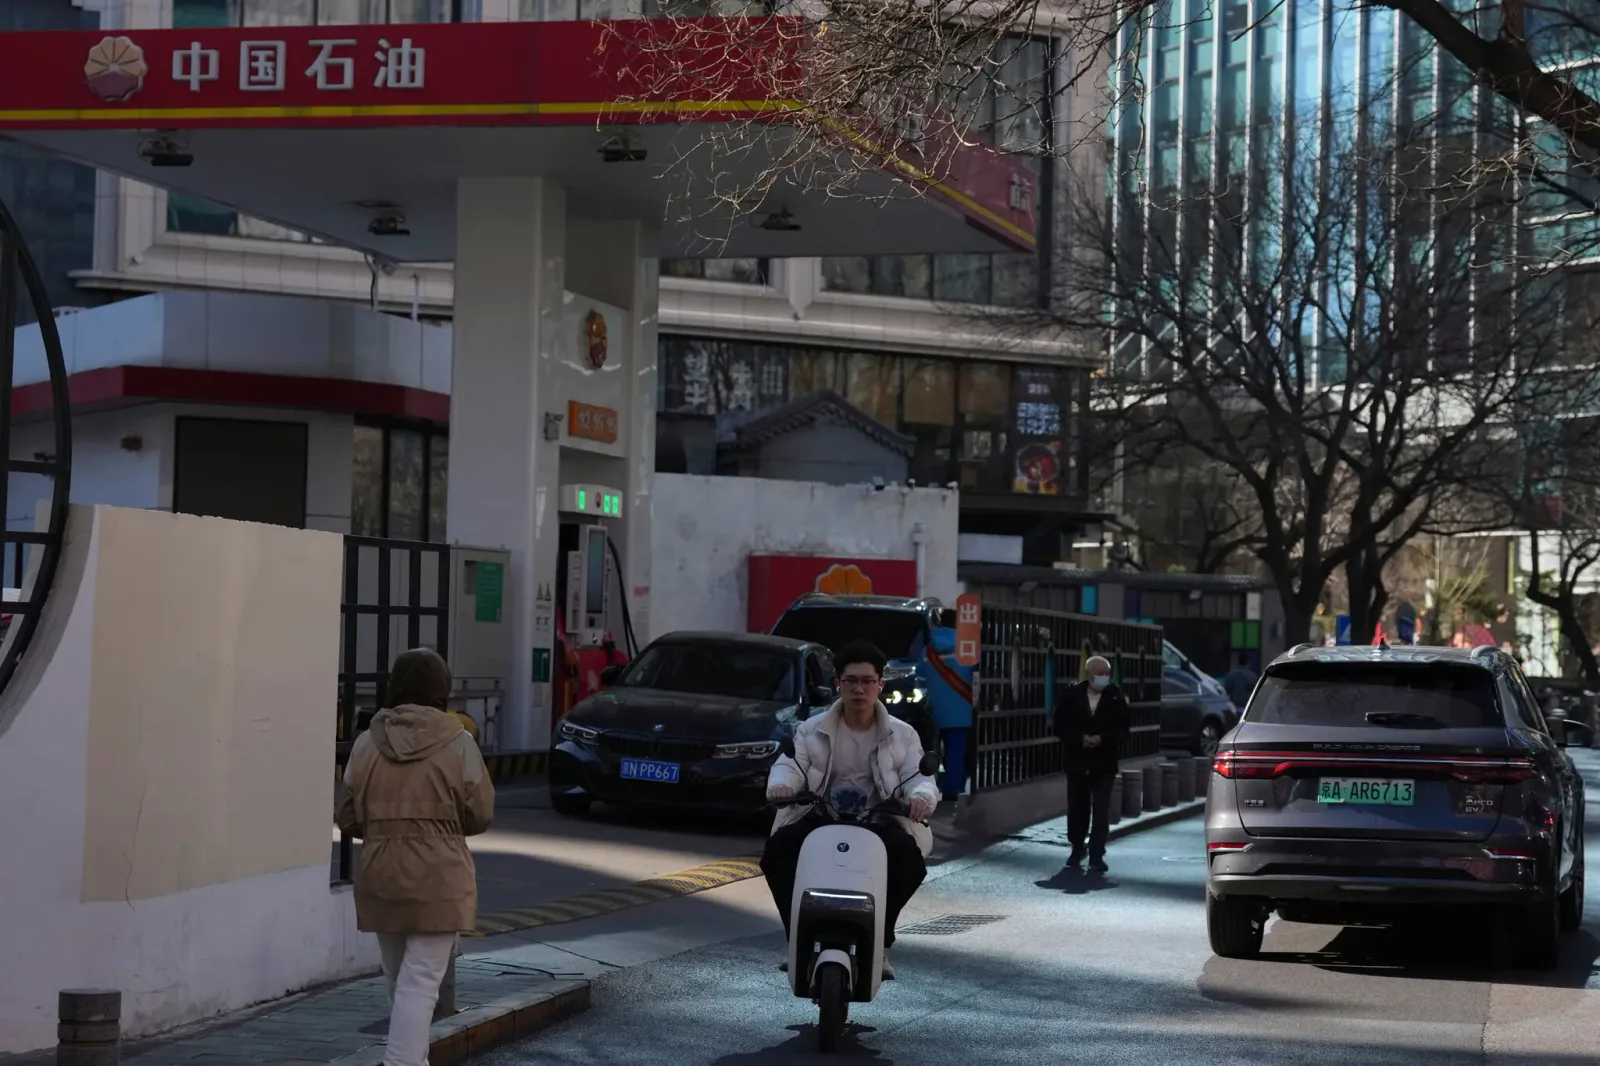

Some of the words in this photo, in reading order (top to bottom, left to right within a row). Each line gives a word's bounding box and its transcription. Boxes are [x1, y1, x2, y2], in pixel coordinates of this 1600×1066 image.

[171, 38, 426, 92] 中国石油
[959, 603, 978, 658] 出口
